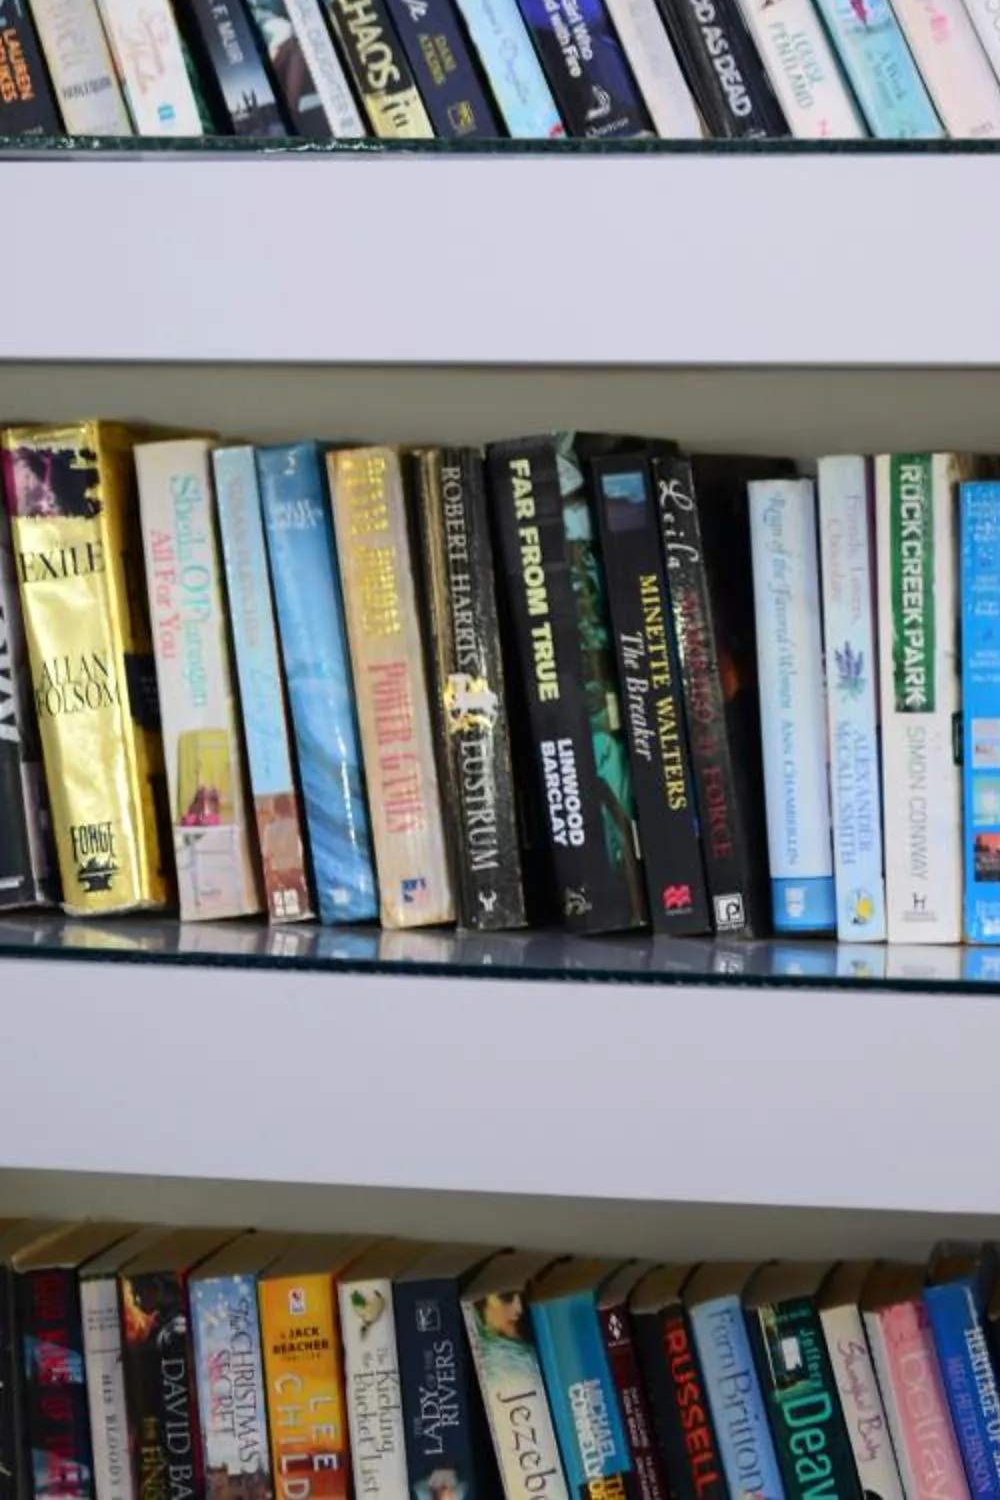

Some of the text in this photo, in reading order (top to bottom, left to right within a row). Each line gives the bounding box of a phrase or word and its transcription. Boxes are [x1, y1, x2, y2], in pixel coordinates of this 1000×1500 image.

[548, 10, 571, 43] with
[561, 39, 582, 78] Fire
[572, 20, 593, 61] Who
[701, 23, 729, 59] AS
[712, 53, 753, 117] DEAD
[19, 541, 105, 583] EXILE
[509, 458, 561, 703] FAR FROM TRUE
[900, 464, 927, 707] ROCK CREEK PARK
[35, 684, 122, 718] FOLSOM
[39, 651, 111, 684] ALLAN
[620, 632, 653, 760] The Breaker
[638, 573, 687, 811] MINETTE WALTERS
[461, 733, 498, 872] LUSTRUM
[539, 740, 568, 847] BARCLAY
[555, 738, 586, 847] LINWOOD
[904, 724, 927, 882] SIMON CONWAY
[160, 1357, 191, 1448] DAVID
[208, 1352, 235, 1435] SECRET
[231, 1329, 262, 1465] CHRISTMAS
[307, 1393, 340, 1472] LEE
[353, 1371, 382, 1494] Bucket List
[374, 1366, 402, 1455] Kicking
[419, 1386, 444, 1456] LADY
[433, 1339, 461, 1428] RIVERS
[662, 1328, 719, 1492] RUSSELL
[706, 1307, 764, 1498] Fern Britton
[275, 1373, 312, 1499] CHILD
